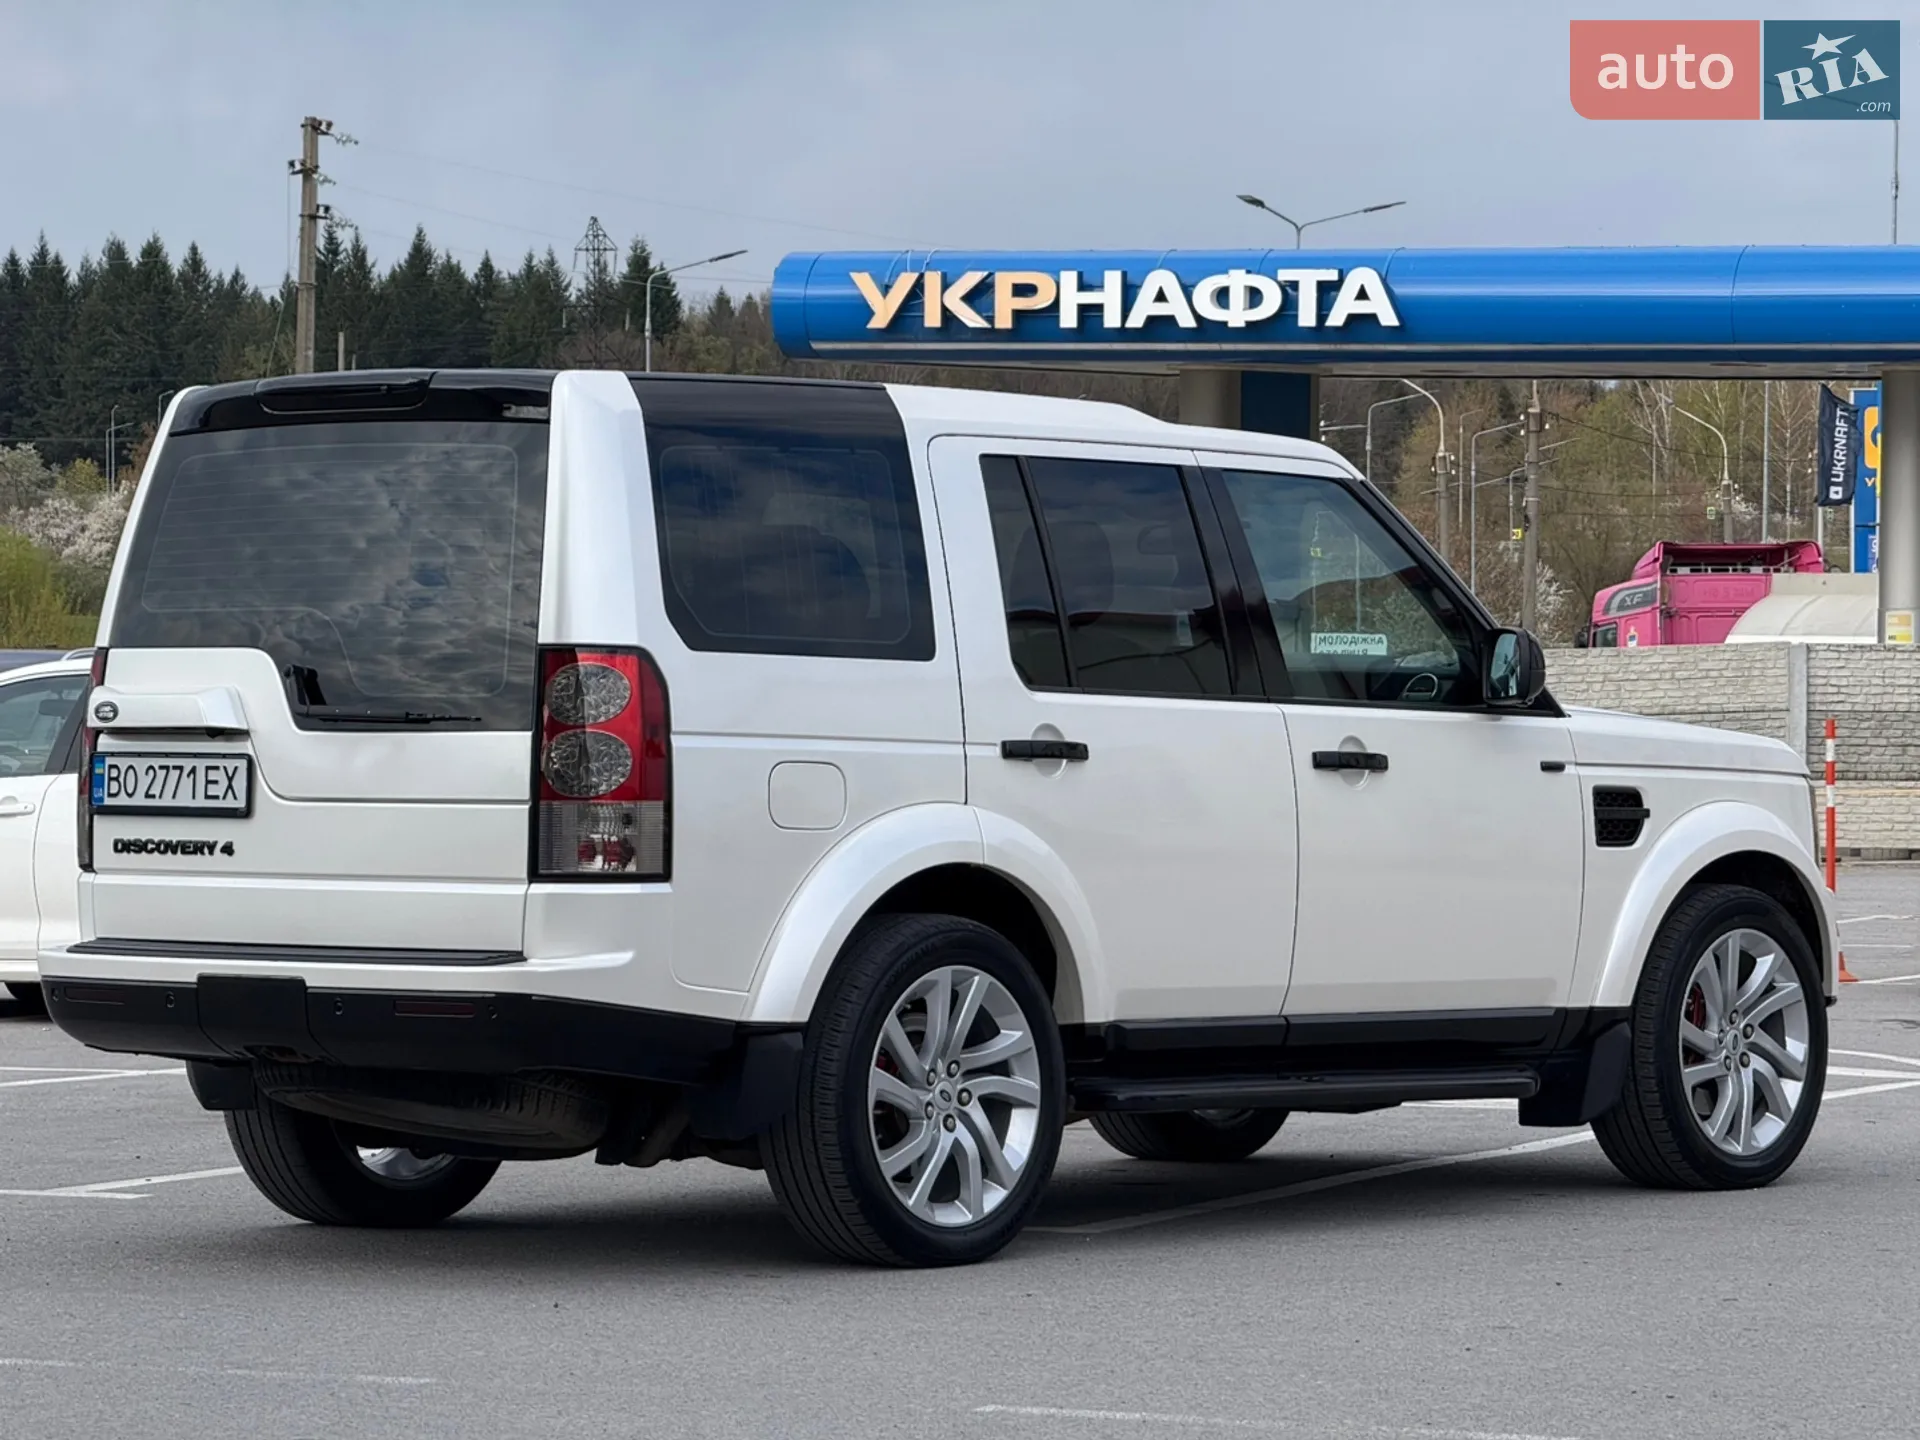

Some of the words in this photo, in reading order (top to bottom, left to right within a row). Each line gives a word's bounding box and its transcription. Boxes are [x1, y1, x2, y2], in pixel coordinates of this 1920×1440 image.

[849, 266, 1400, 330] УКРНАФТА
[1830, 404, 1849, 483] UKRNAFT
[1624, 593, 1644, 607] XF
[1318, 635, 1384, 647] МОЛОДІЖНА
[106, 763, 138, 799] BO
[144, 764, 197, 800] 2771
[204, 765, 239, 801] EX
[113, 838, 218, 856] DISCOVERY
[219, 841, 235, 857] 4
